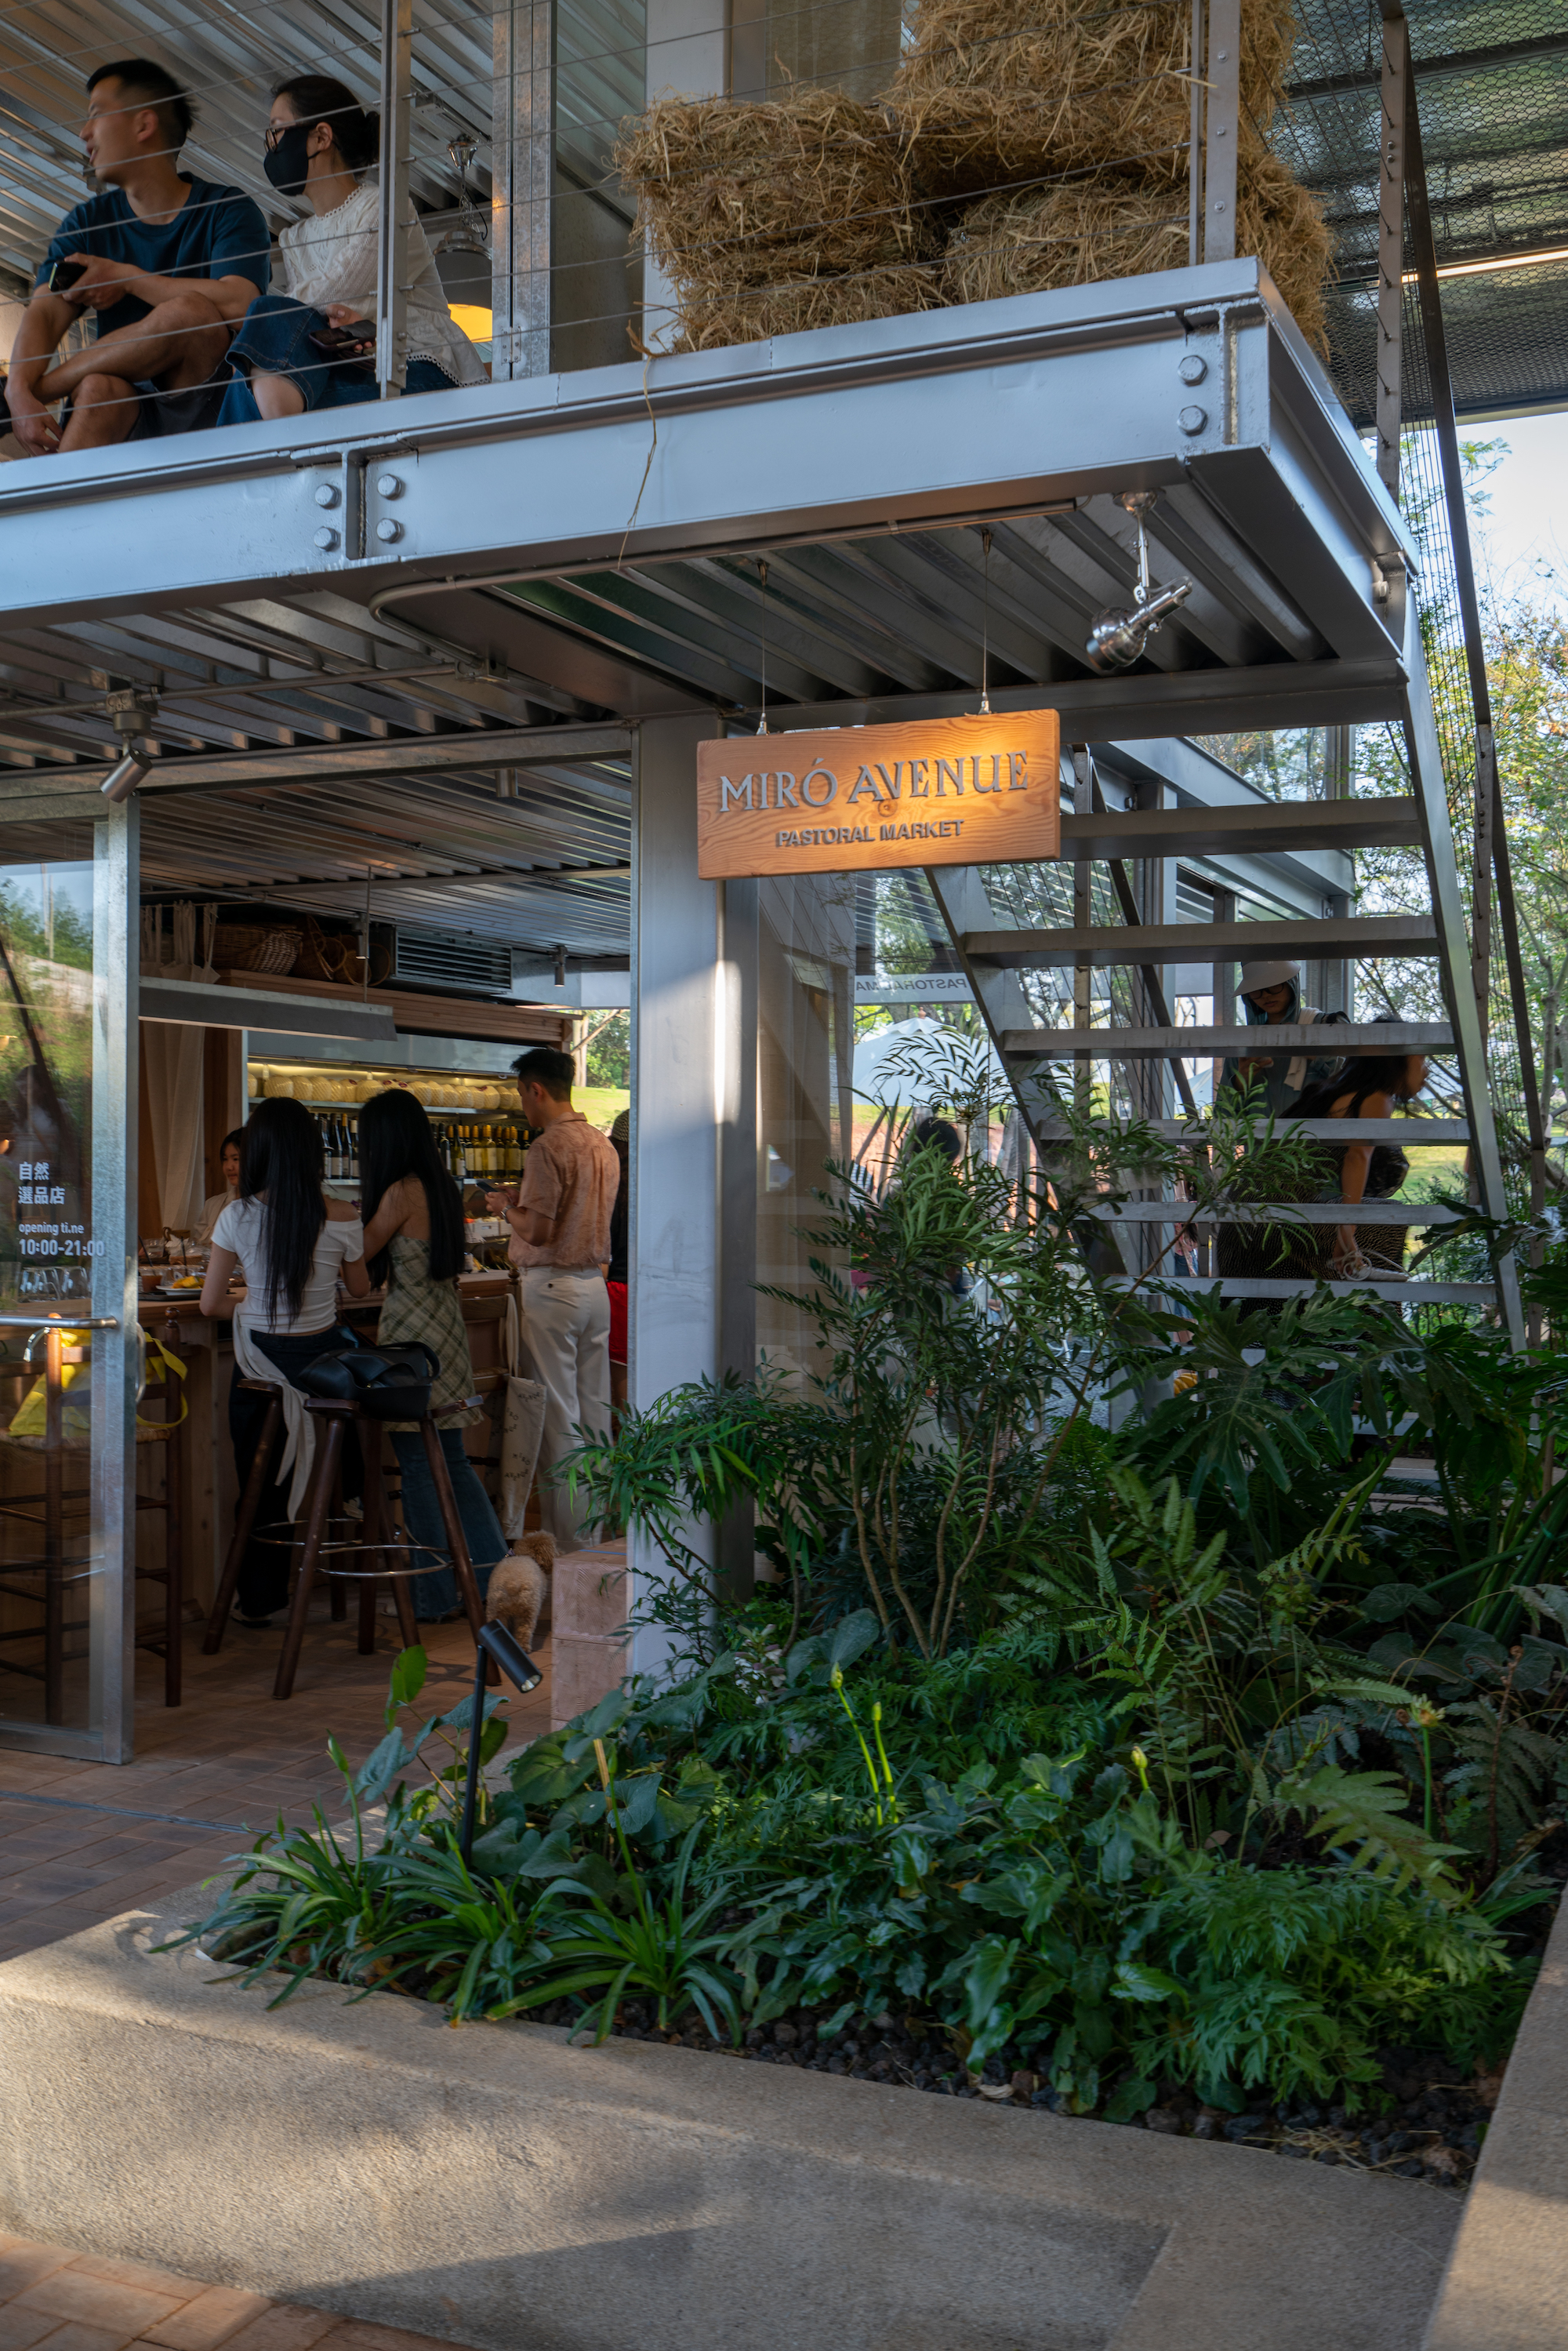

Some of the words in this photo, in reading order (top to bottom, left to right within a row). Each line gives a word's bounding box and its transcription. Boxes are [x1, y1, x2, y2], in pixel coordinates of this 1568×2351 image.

[720, 758, 838, 812] MIRÓ
[846, 750, 1029, 804] AVENUE
[778, 825, 876, 847] PASTORAL
[880, 819, 965, 841] MARKET
[19, 1161, 50, 1181] 自然
[18, 1185, 66, 1205] 選品店
[18, 1221, 60, 1236] opening
[19, 1238, 105, 1257] 10:00-21:00
